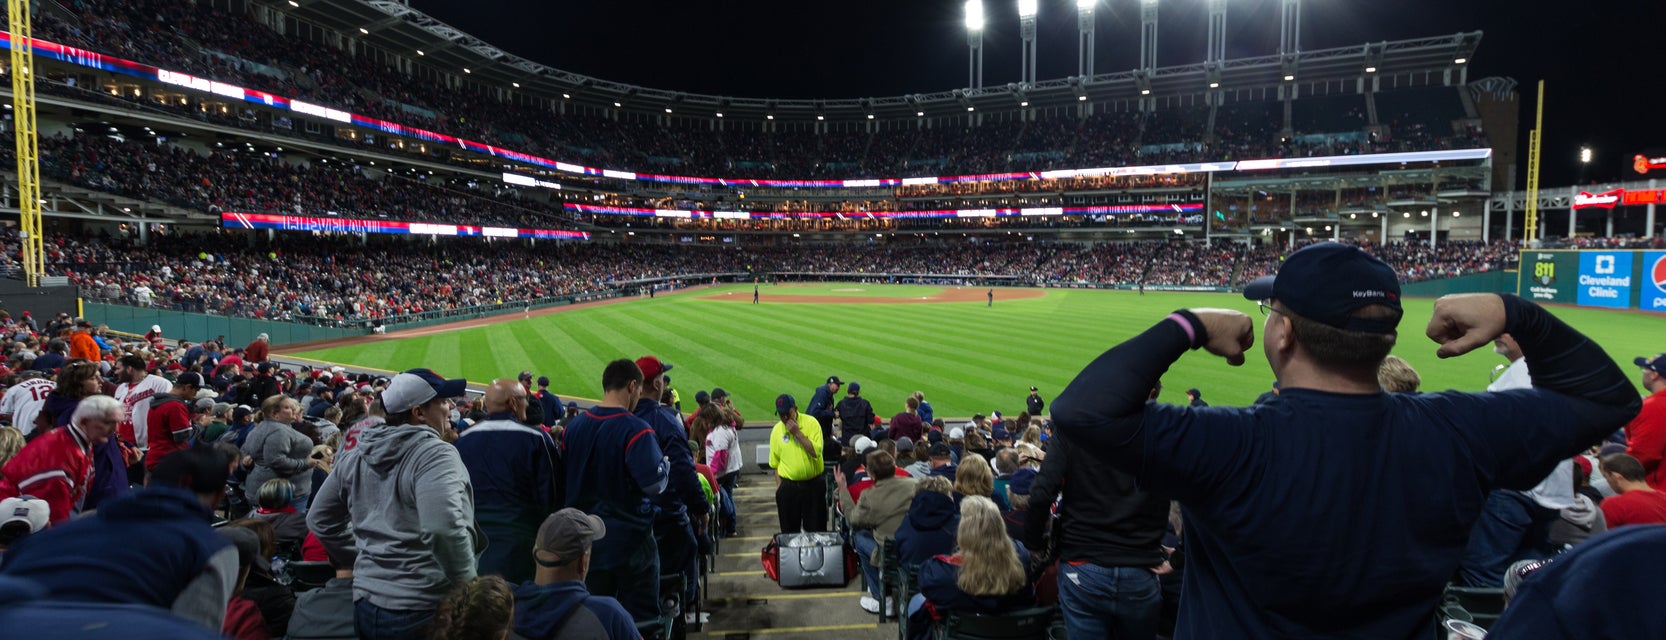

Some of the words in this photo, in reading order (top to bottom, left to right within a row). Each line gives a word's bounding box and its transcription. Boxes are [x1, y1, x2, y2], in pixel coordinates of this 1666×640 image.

[1535, 262, 1554, 277] 811
[1579, 274, 1630, 287] Cleveland
[1352, 290, 1385, 298] KeyBank
[1588, 286, 1618, 298] Clinic
[29, 385, 52, 401] 12
[344, 429, 361, 451] 5
